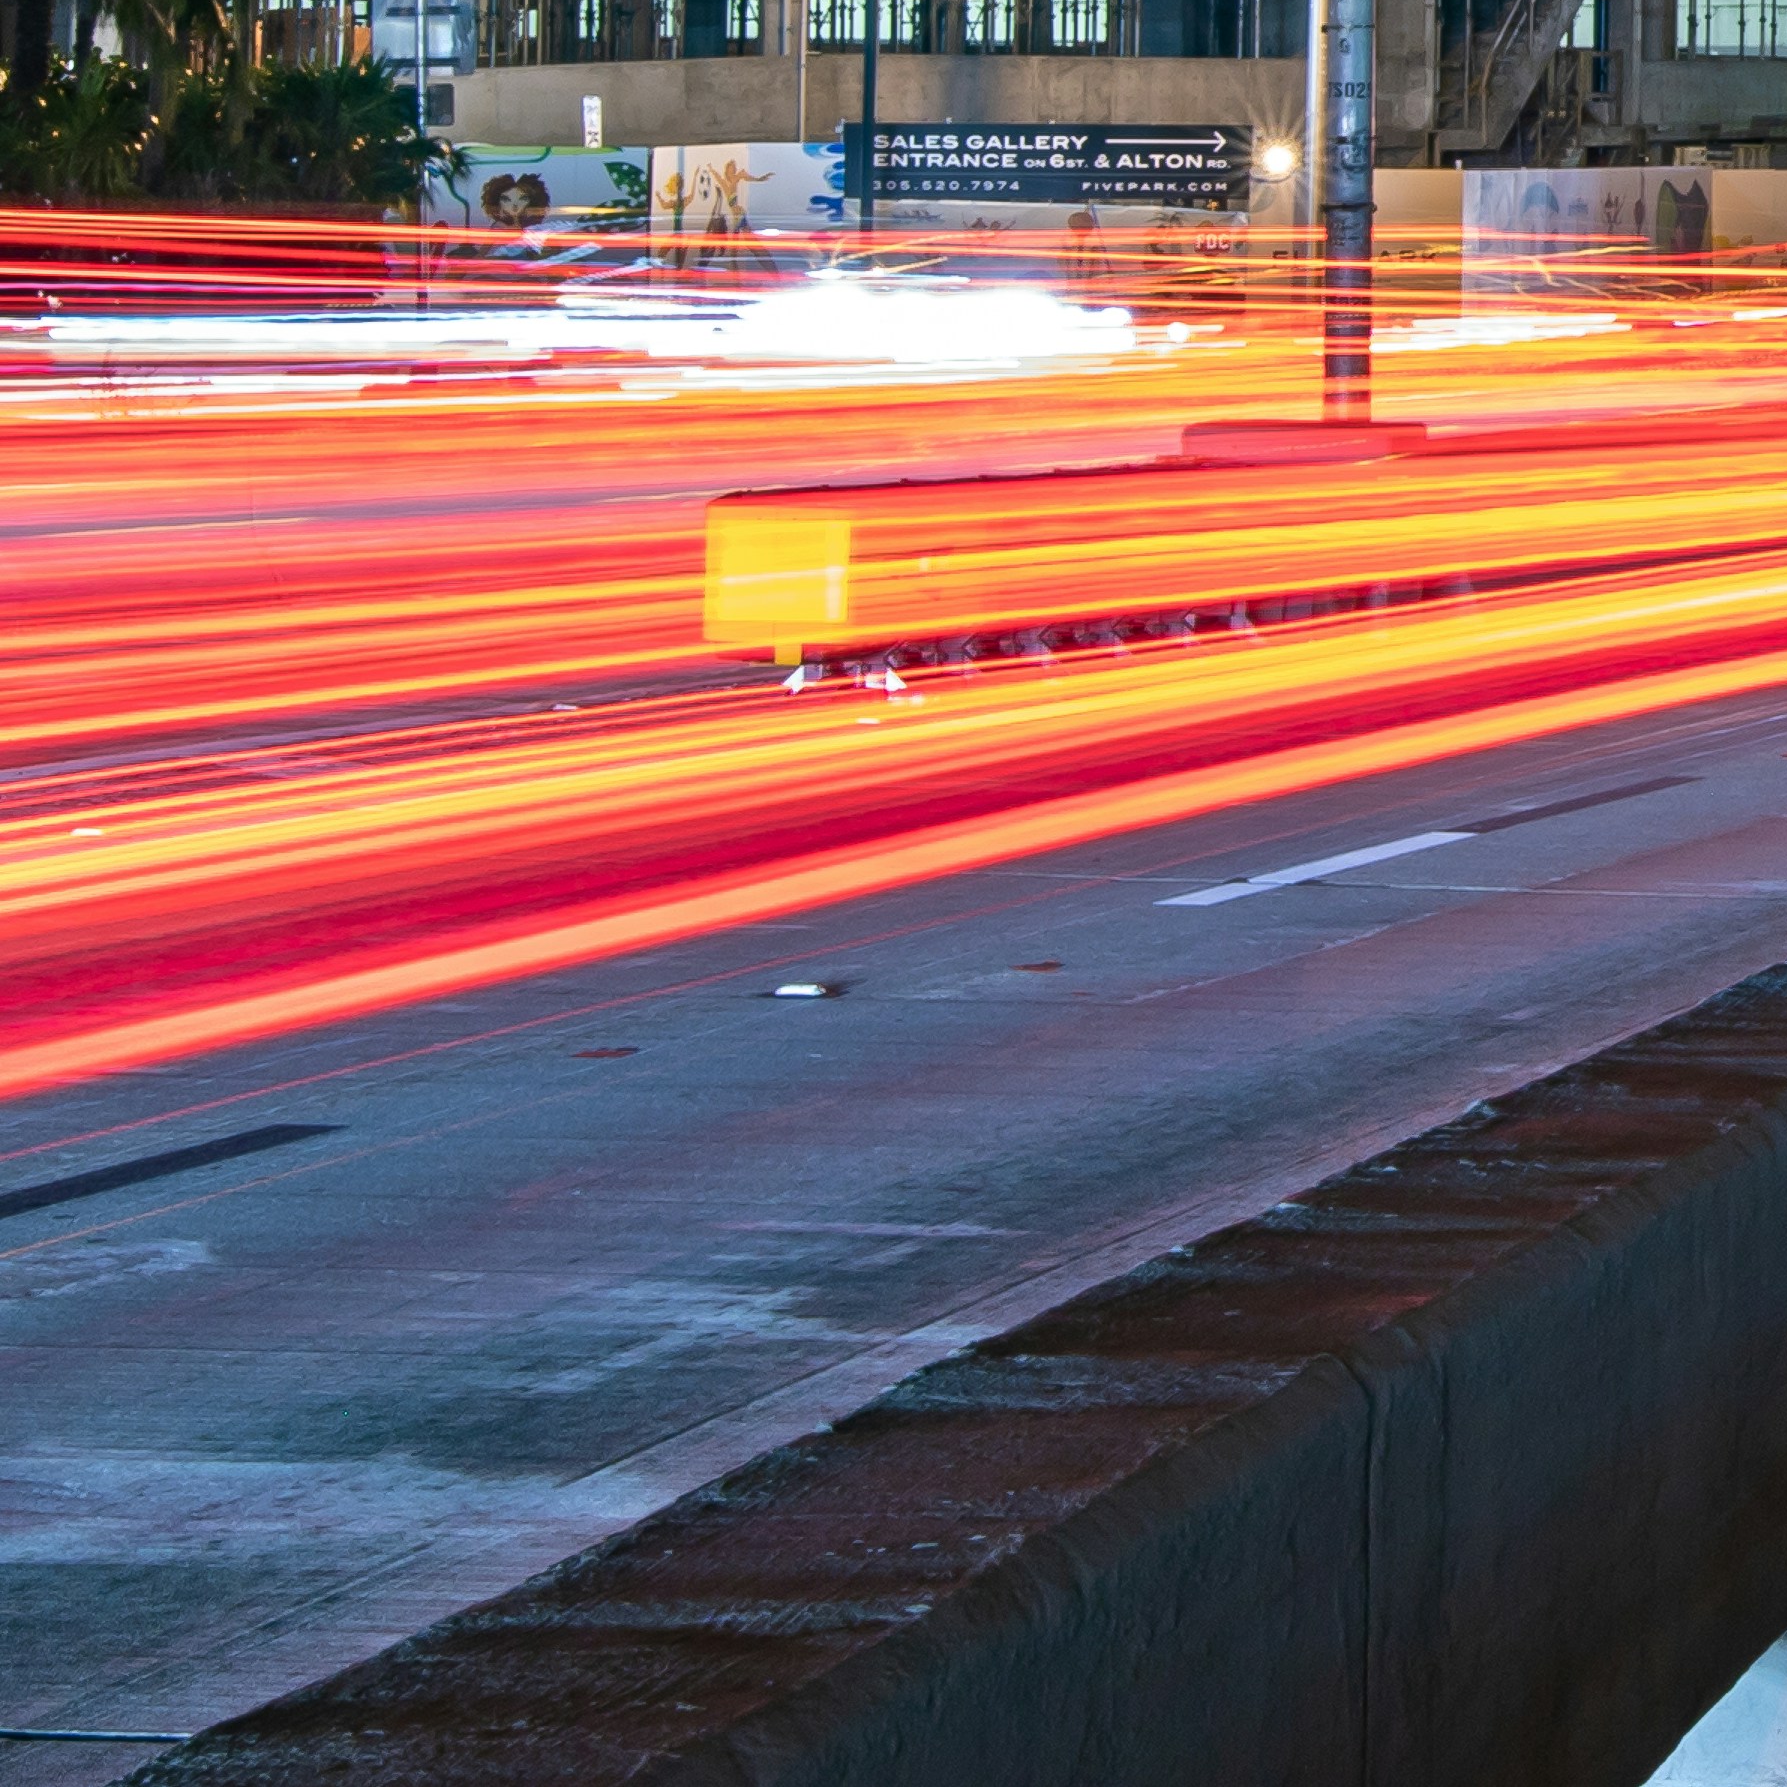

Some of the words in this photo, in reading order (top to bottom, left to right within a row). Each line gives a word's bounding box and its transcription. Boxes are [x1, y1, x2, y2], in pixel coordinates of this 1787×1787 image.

[873, 134, 959, 150] SALES
[965, 134, 1089, 150] GALLERY
[873, 153, 1018, 168] ENTRANCE
[1023, 158, 1047, 168] ON
[1094, 153, 1111, 169] &
[1116, 153, 1204, 169] ALTON
[1080, 181, 1228, 192] FIVEPARK.COM
